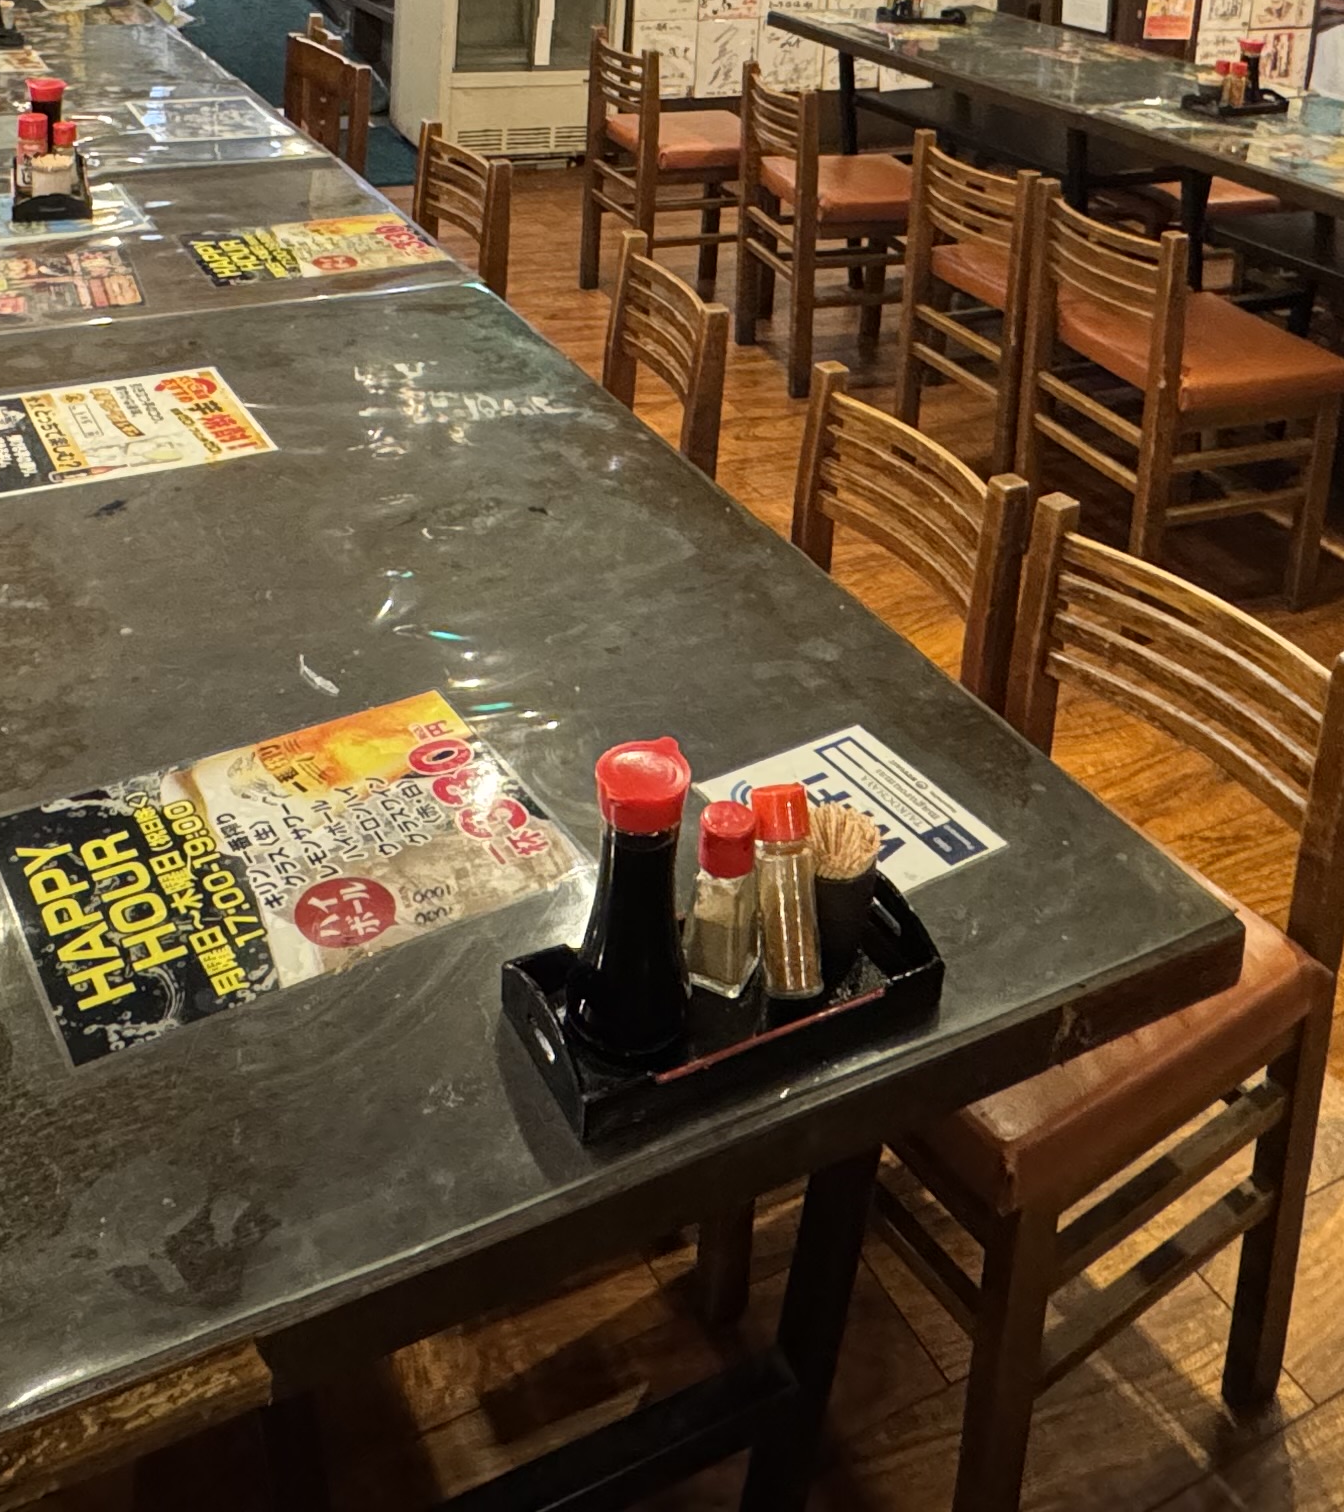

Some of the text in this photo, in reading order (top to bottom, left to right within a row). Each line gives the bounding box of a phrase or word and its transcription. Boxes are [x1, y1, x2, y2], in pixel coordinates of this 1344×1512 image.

[190, 240, 242, 278] HAPPY
[220, 239, 263, 271] HOUR
[273, 800, 342, 879] レモンサワー
[306, 797, 368, 862] ハイボール
[332, 782, 402, 857] ウーロンハイ
[360, 773, 431, 846] グラスワイン
[160, 799, 269, 946] 17:00-19:00
[210, 810, 289, 910] キリン 一番搾り
[17, 846, 138, 1011] HAPPY
[77, 832, 192, 975] HOUR
[308, 895, 341, 937] ハイ
[339, 881, 381, 936] ボール
